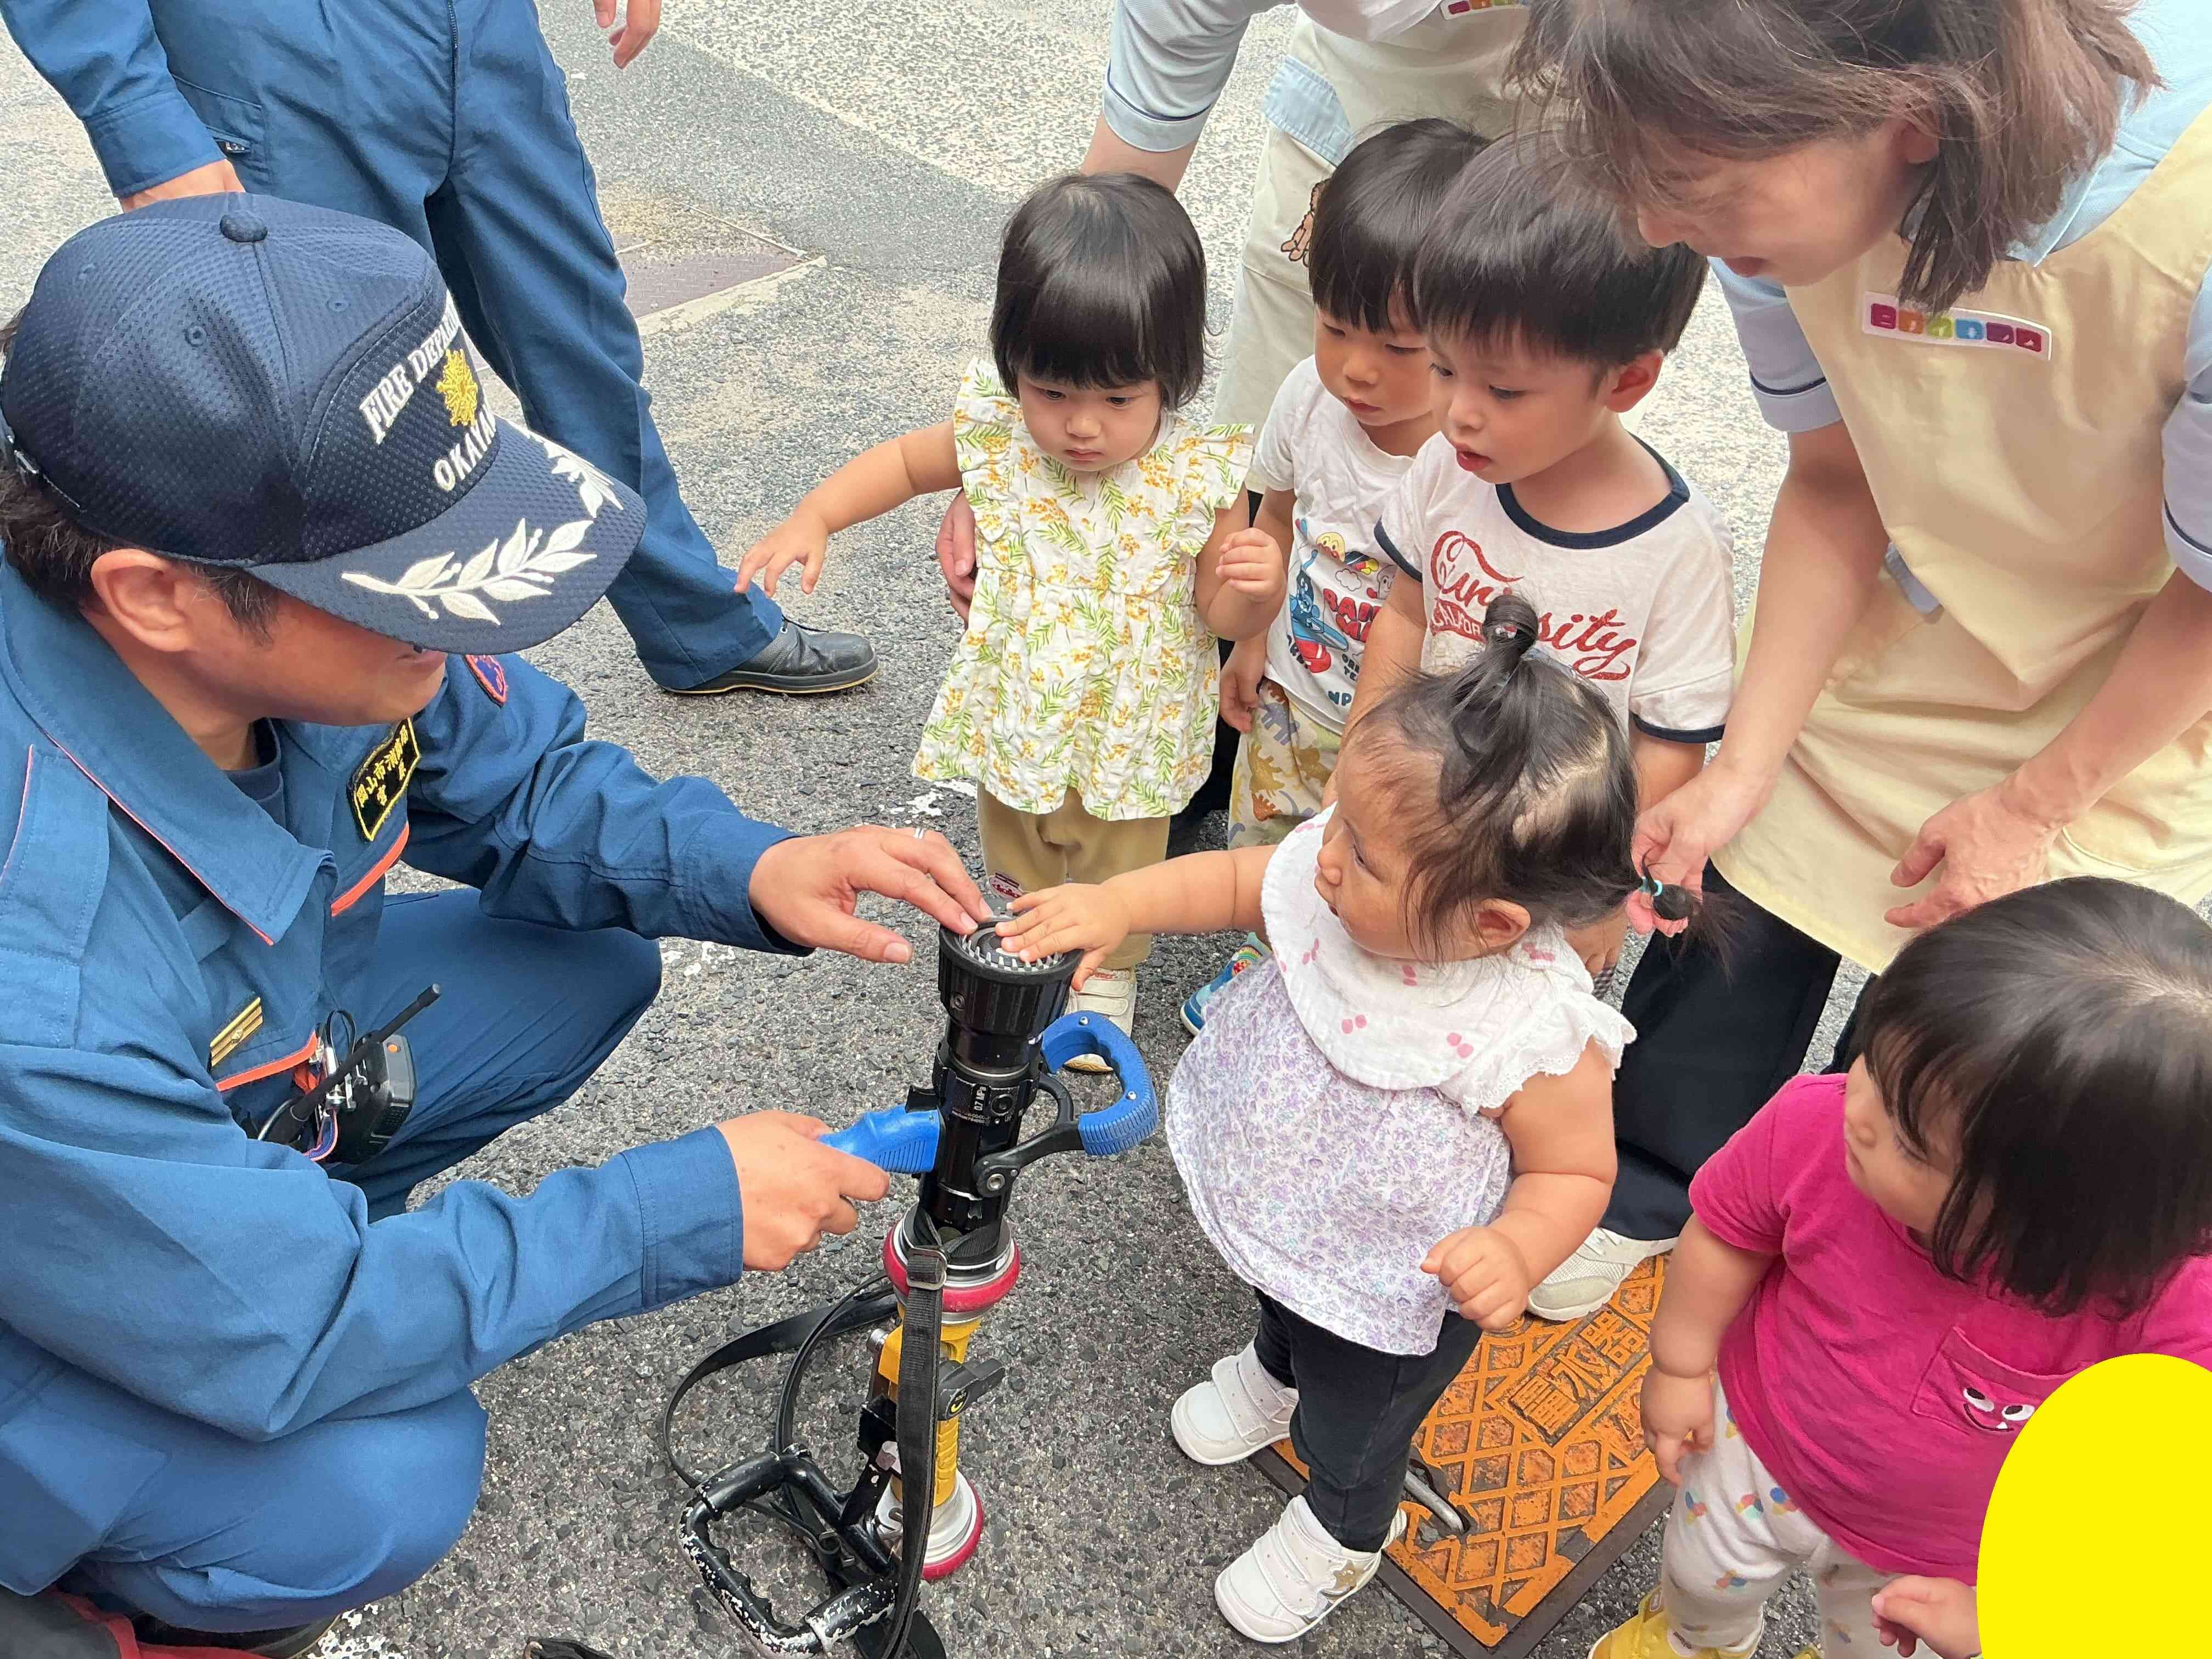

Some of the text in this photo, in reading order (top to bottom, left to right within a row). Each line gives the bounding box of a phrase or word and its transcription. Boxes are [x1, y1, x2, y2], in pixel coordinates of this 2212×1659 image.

[359, 289, 461, 444] FIRE DEPAR
[1431, 602, 1481, 636] CALIFOR
